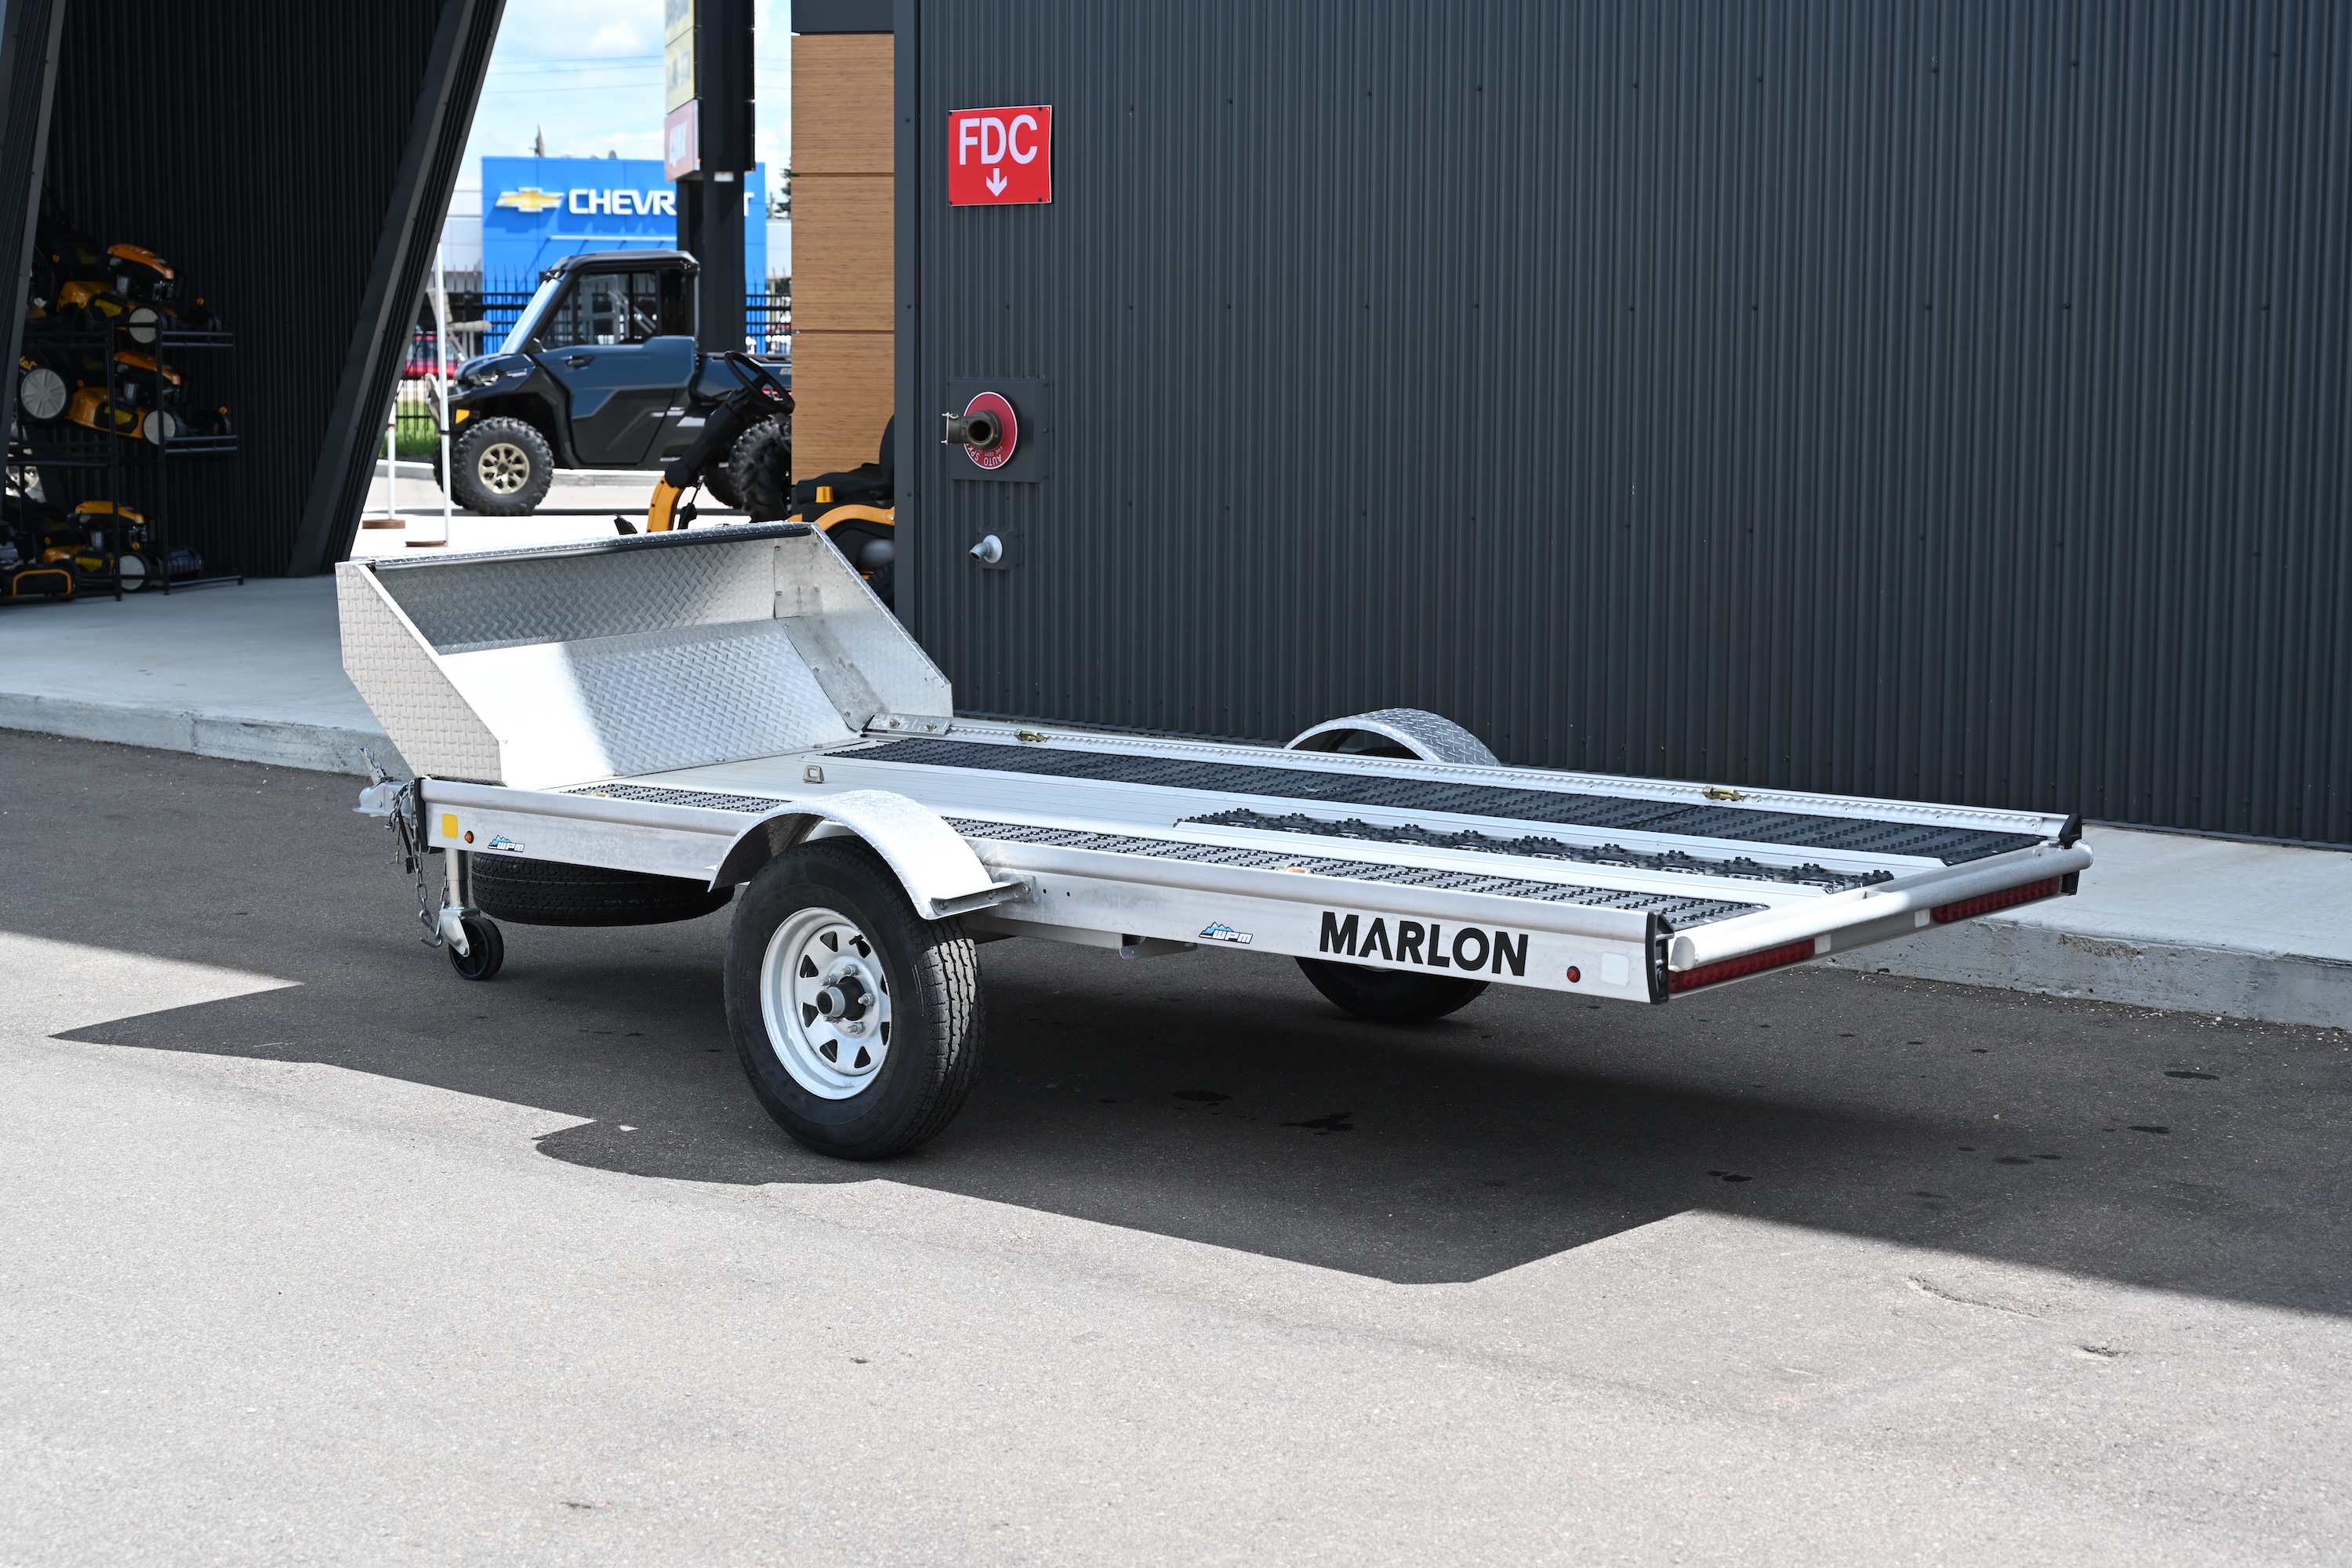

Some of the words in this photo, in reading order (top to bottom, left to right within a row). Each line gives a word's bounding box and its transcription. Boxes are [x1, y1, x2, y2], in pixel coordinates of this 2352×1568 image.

[959, 114, 1037, 165] FDC
[568, 188, 754, 216] CHEVRT
[983, 454, 1001, 466] AUTO
[496, 841, 525, 853] WPM
[1211, 929, 1253, 944] WPM
[1319, 911, 1528, 976] MARLON
